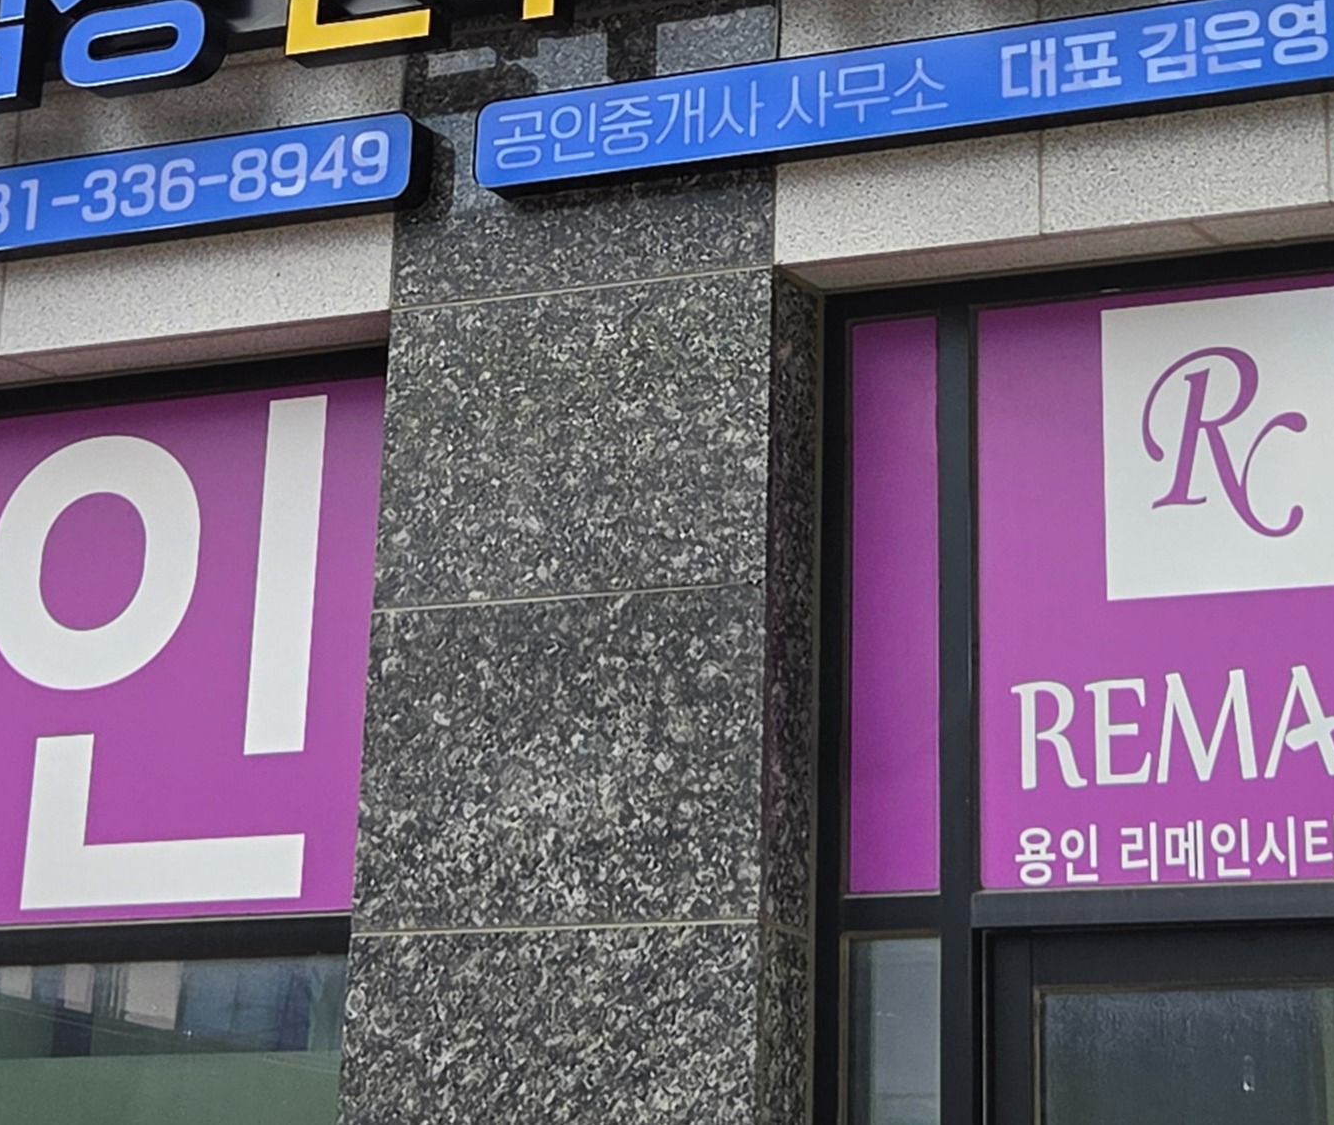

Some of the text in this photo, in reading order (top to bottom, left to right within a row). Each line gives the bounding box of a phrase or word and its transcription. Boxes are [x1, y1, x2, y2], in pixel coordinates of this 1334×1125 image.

[490, 75, 765, 171] 공인중개사
[776, 62, 950, 134] 사무소
[999, 29, 1125, 101] 대표
[1014, 825, 1100, 886] 용인
